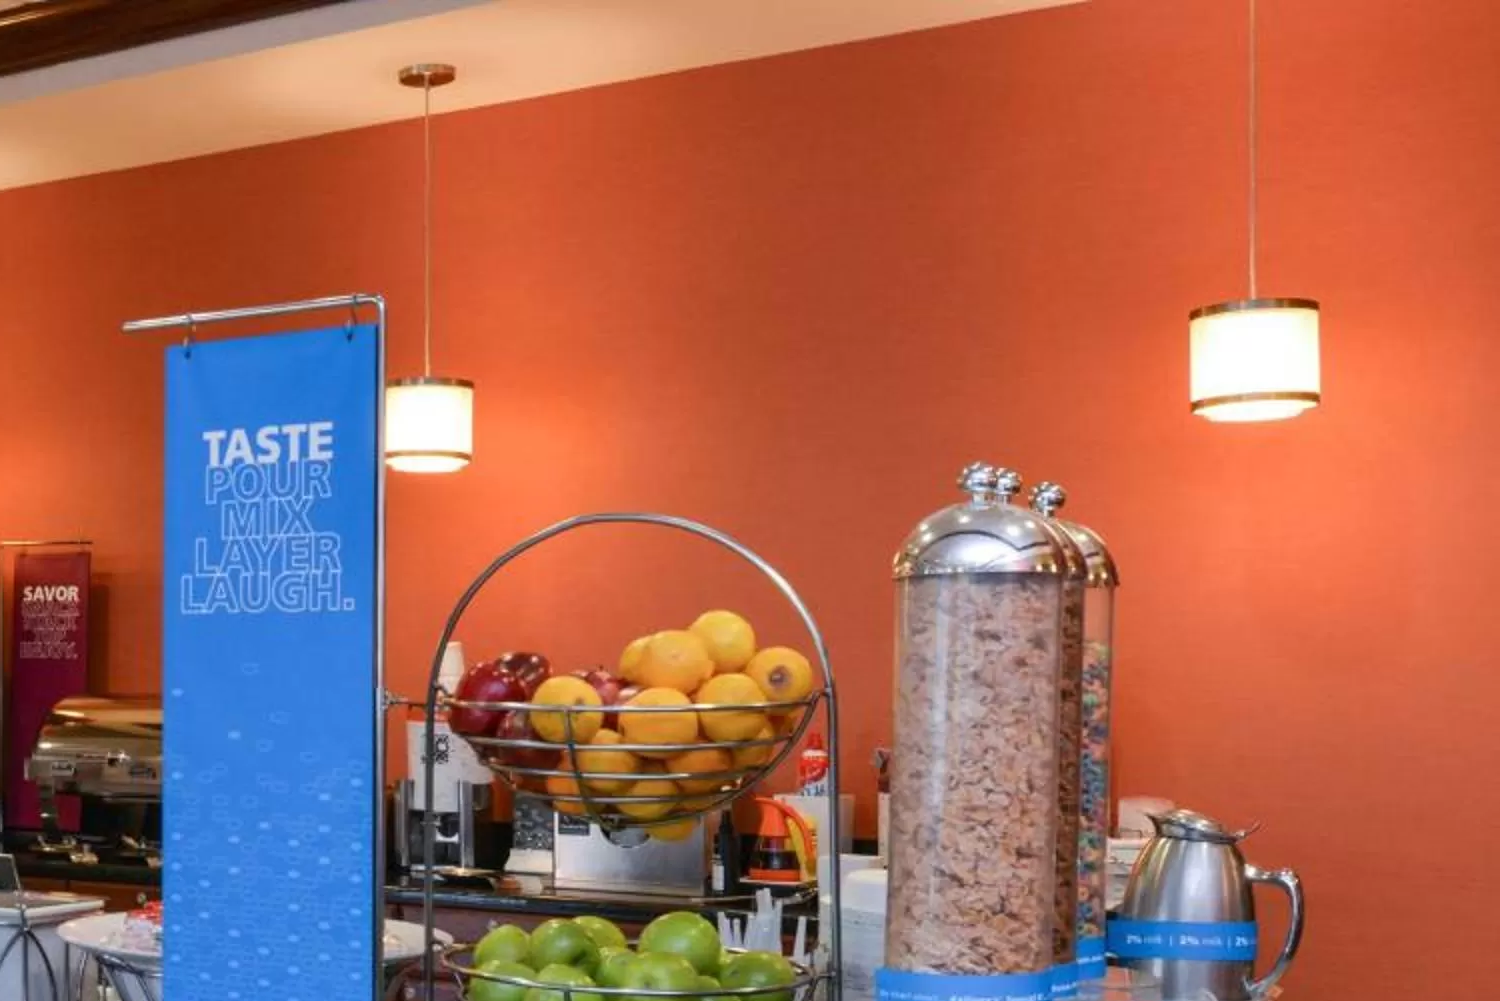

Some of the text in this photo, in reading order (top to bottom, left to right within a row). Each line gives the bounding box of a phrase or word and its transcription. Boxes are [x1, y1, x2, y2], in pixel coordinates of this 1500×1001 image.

[202, 421, 334, 467] TASTE
[205, 459, 333, 505] POUR
[221, 496, 314, 540] MIX
[195, 532, 342, 577] LAYER
[23, 585, 79, 602] SAVOR
[180, 565, 356, 615] LAUGH.
